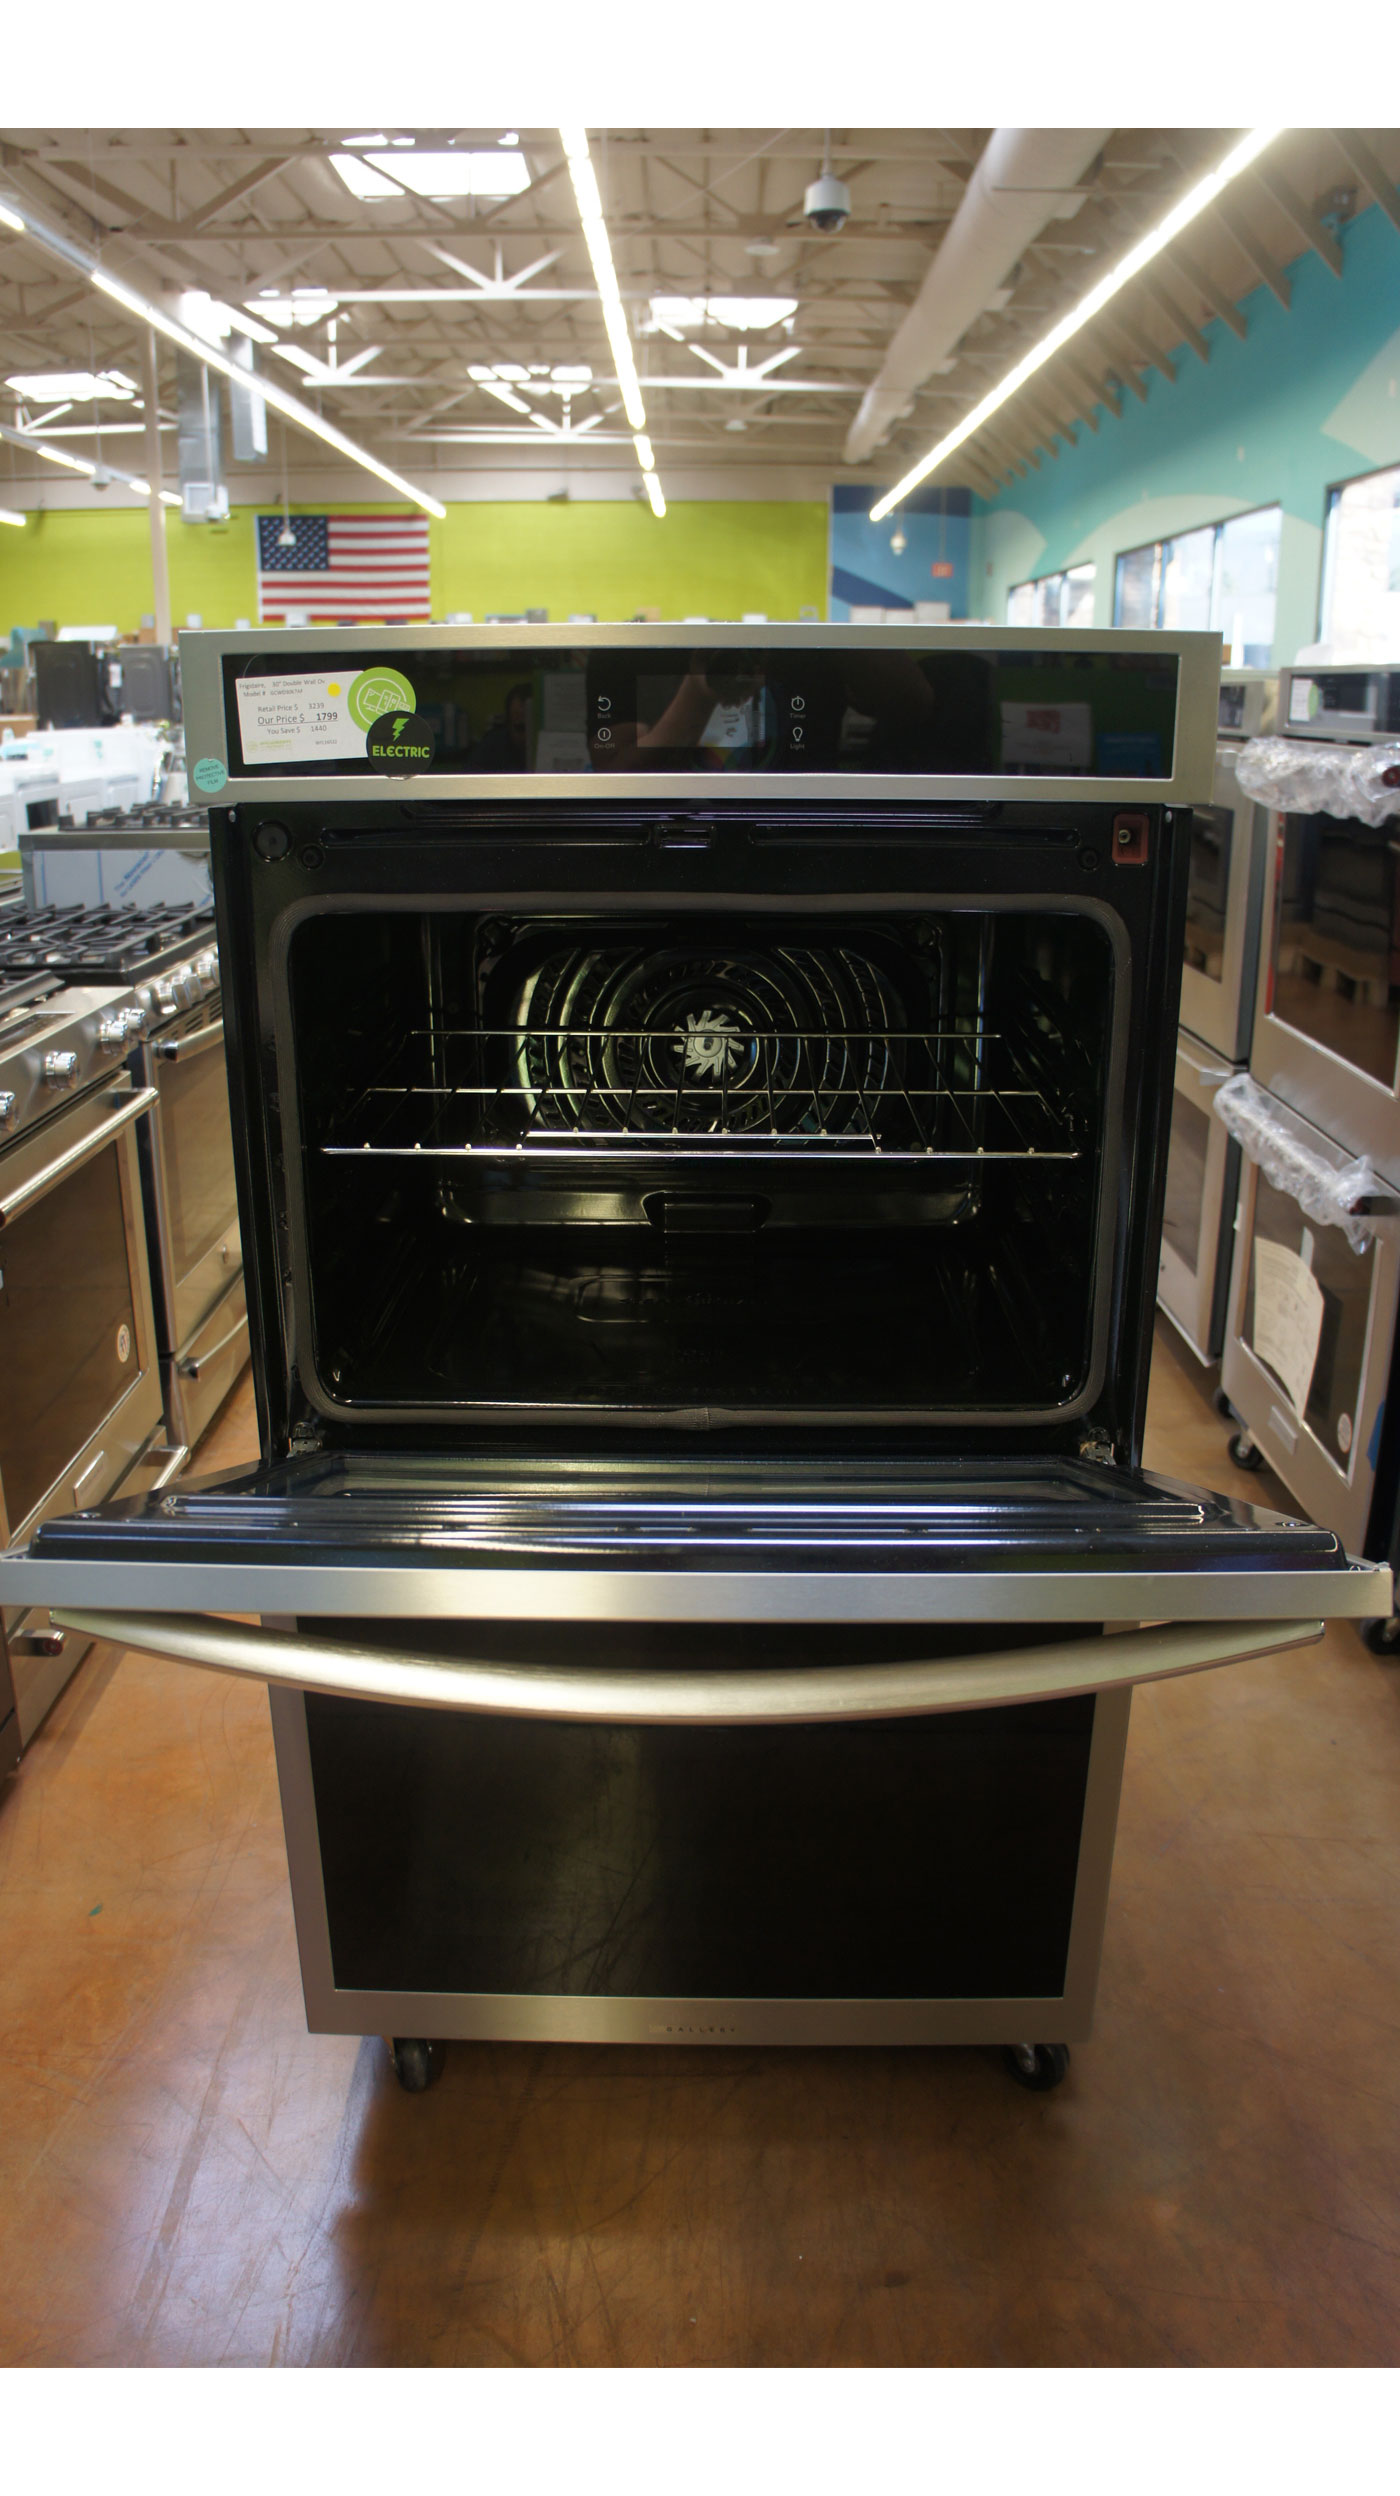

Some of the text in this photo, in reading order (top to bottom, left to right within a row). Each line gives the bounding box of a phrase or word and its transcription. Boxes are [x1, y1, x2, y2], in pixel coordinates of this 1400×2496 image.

[258, 704, 276, 713] Retail
[277, 703, 292, 711] Price
[308, 702, 325, 710] 3239
[257, 711, 338, 725] Our Price $ 1799
[267, 727, 279, 735] You
[311, 724, 327, 732] 1440
[372, 745, 431, 759] ELECTRIC
[790, 742, 805, 751] Light
